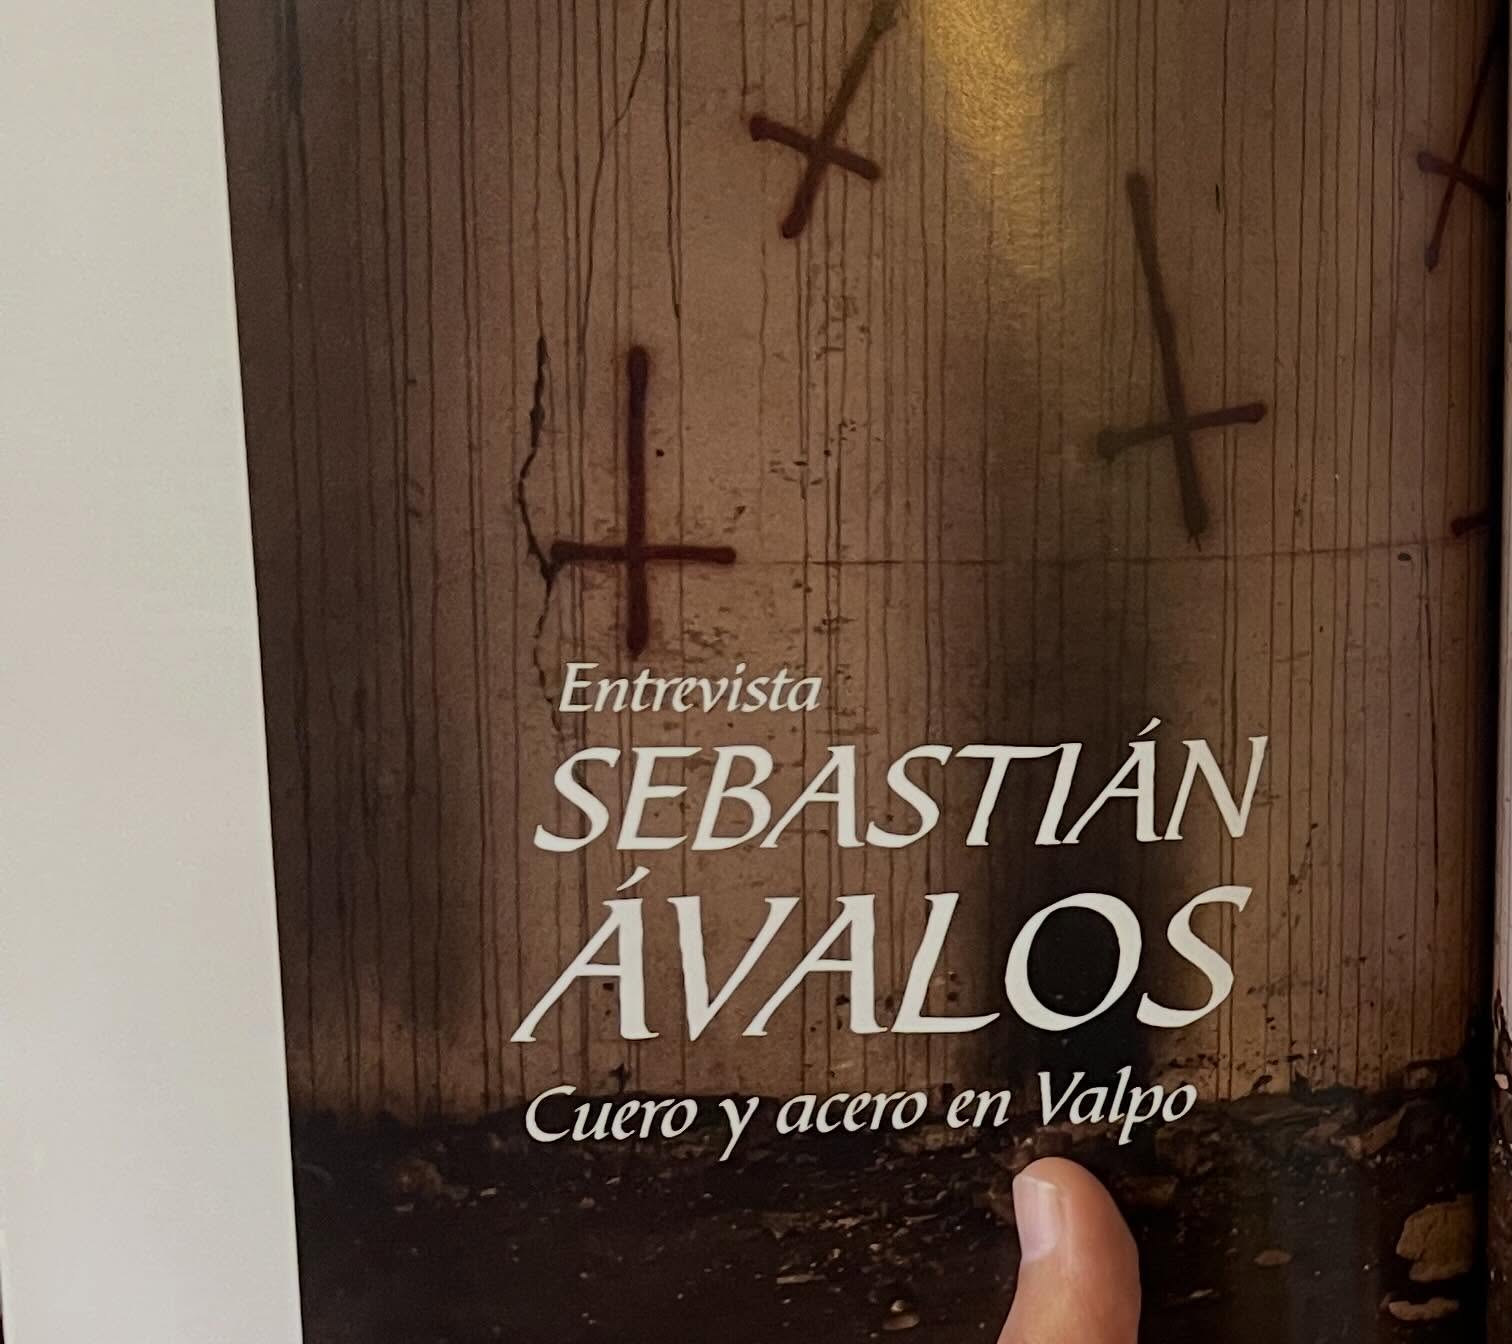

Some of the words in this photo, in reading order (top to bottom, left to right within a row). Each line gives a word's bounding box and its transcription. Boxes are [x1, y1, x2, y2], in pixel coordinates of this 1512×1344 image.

[558, 661, 823, 714] Entrevista
[533, 717, 1269, 853] SEBASTIÁN
[510, 866, 1253, 1044] ÁVALOS
[524, 1085, 699, 1145] Cuero
[717, 1095, 760, 1162] y
[775, 1085, 929, 1134] acero
[946, 1085, 1010, 1130] en
[1037, 1065, 1199, 1146] Valpo
